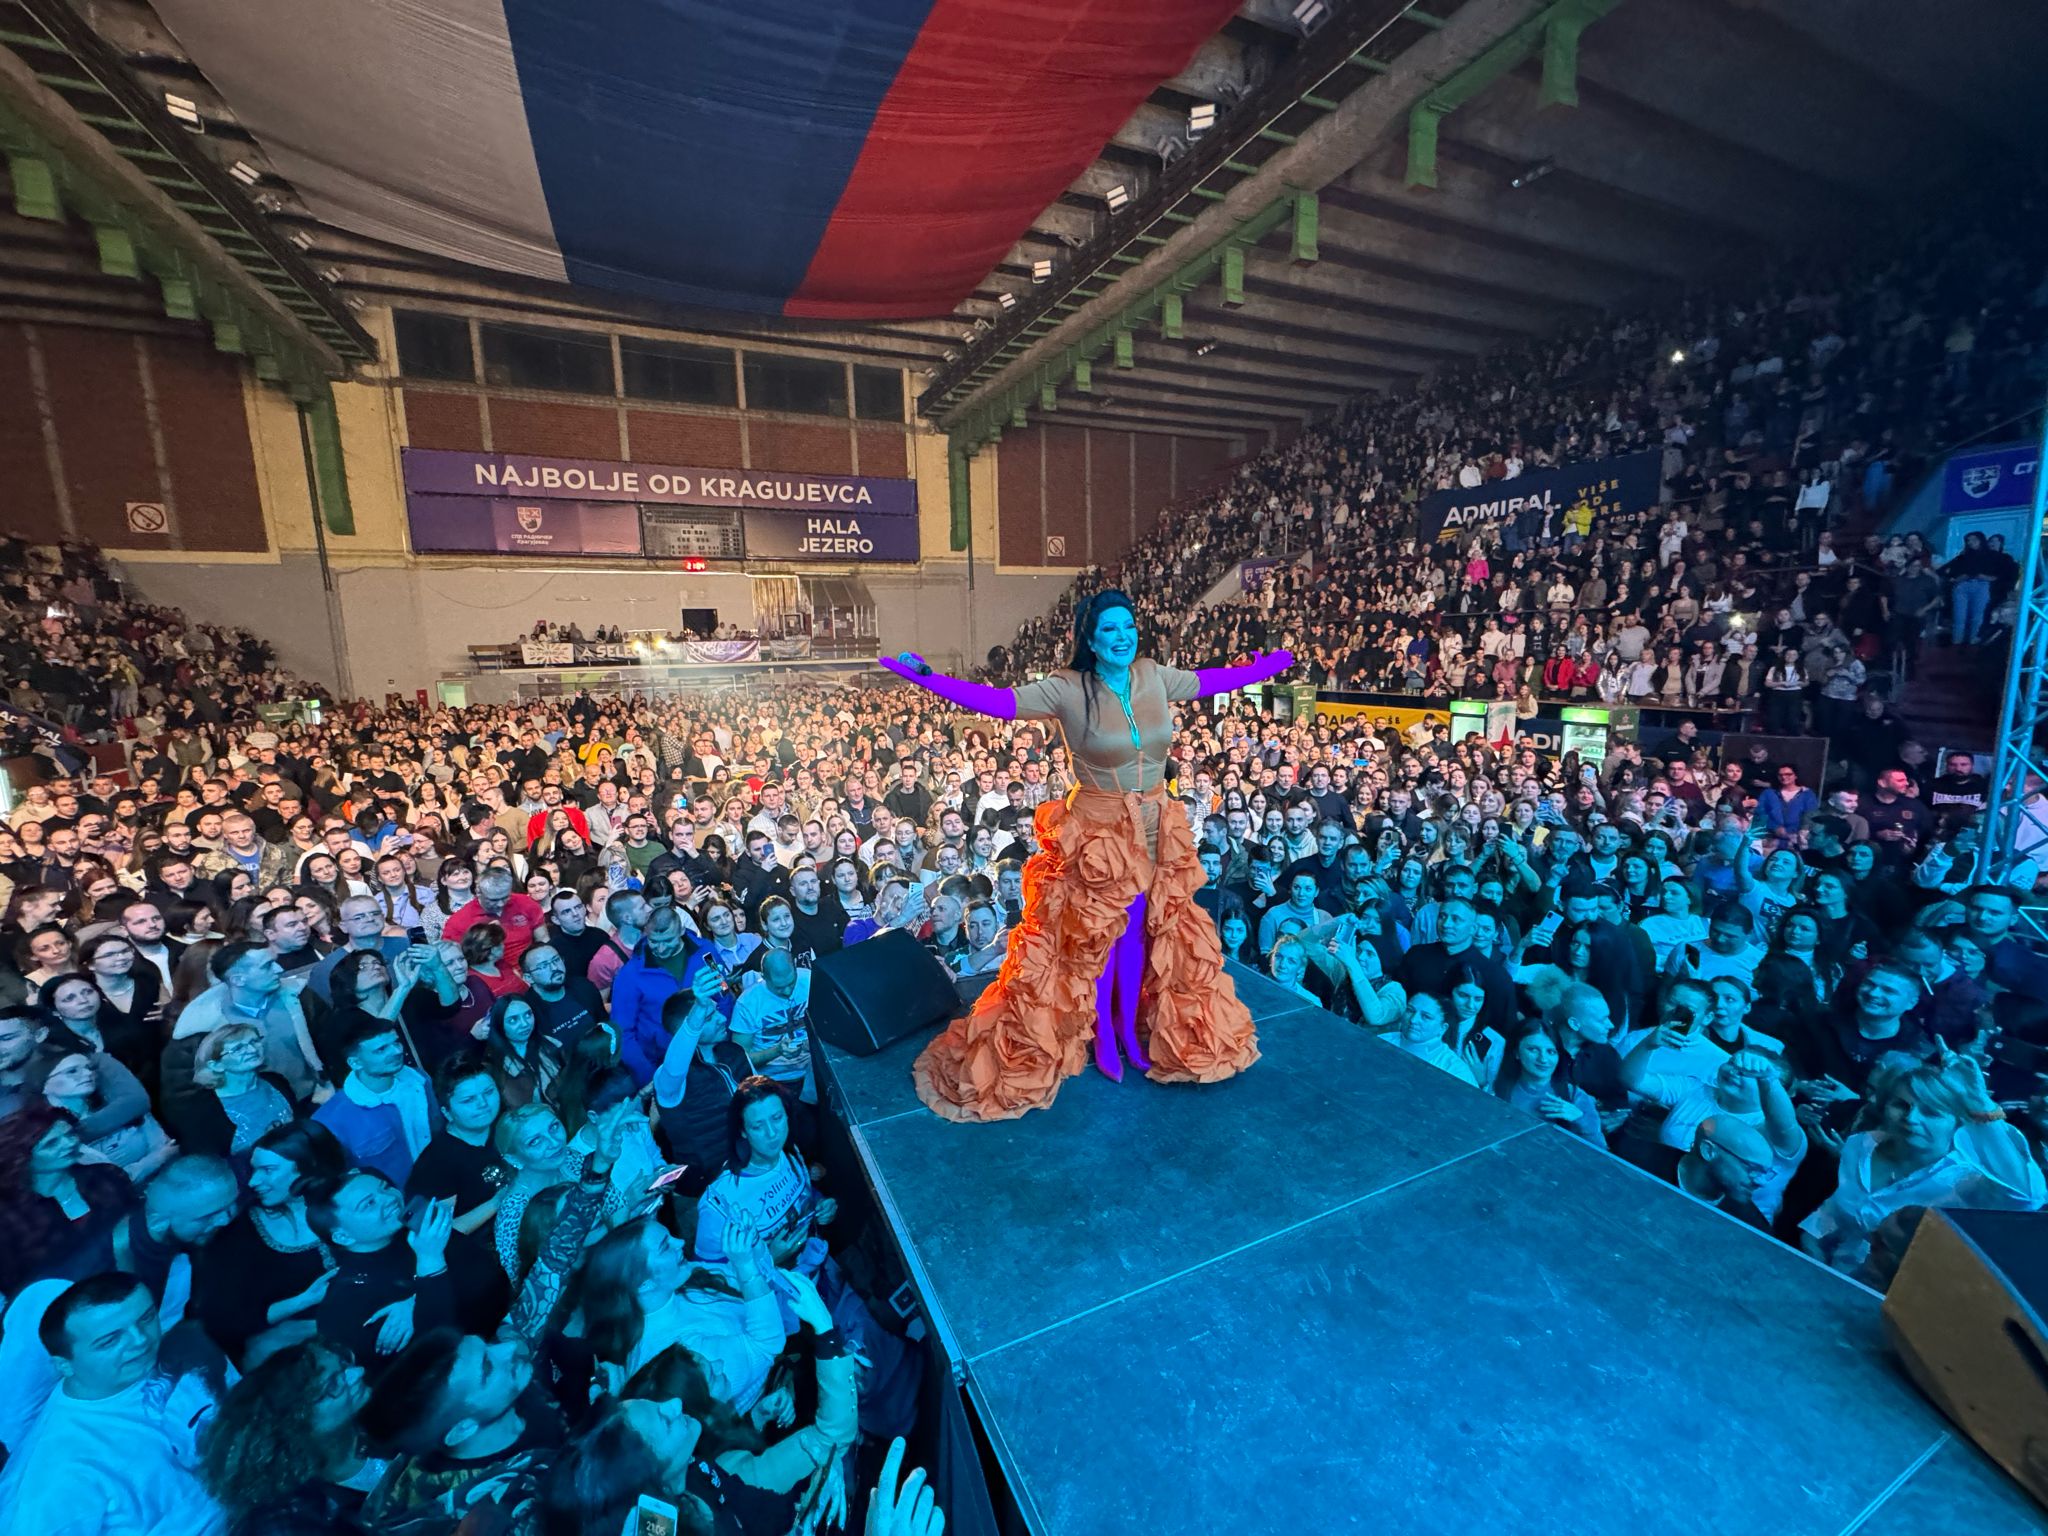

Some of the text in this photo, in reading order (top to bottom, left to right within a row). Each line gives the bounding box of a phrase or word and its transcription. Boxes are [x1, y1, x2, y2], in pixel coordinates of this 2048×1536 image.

[475, 463, 873, 504] NAJBOLJE OD KRAGUJEVCA
[1442, 489, 1561, 527] ADMIRAL
[807, 518, 861, 534] HALA
[798, 537, 873, 553] JEZERO
